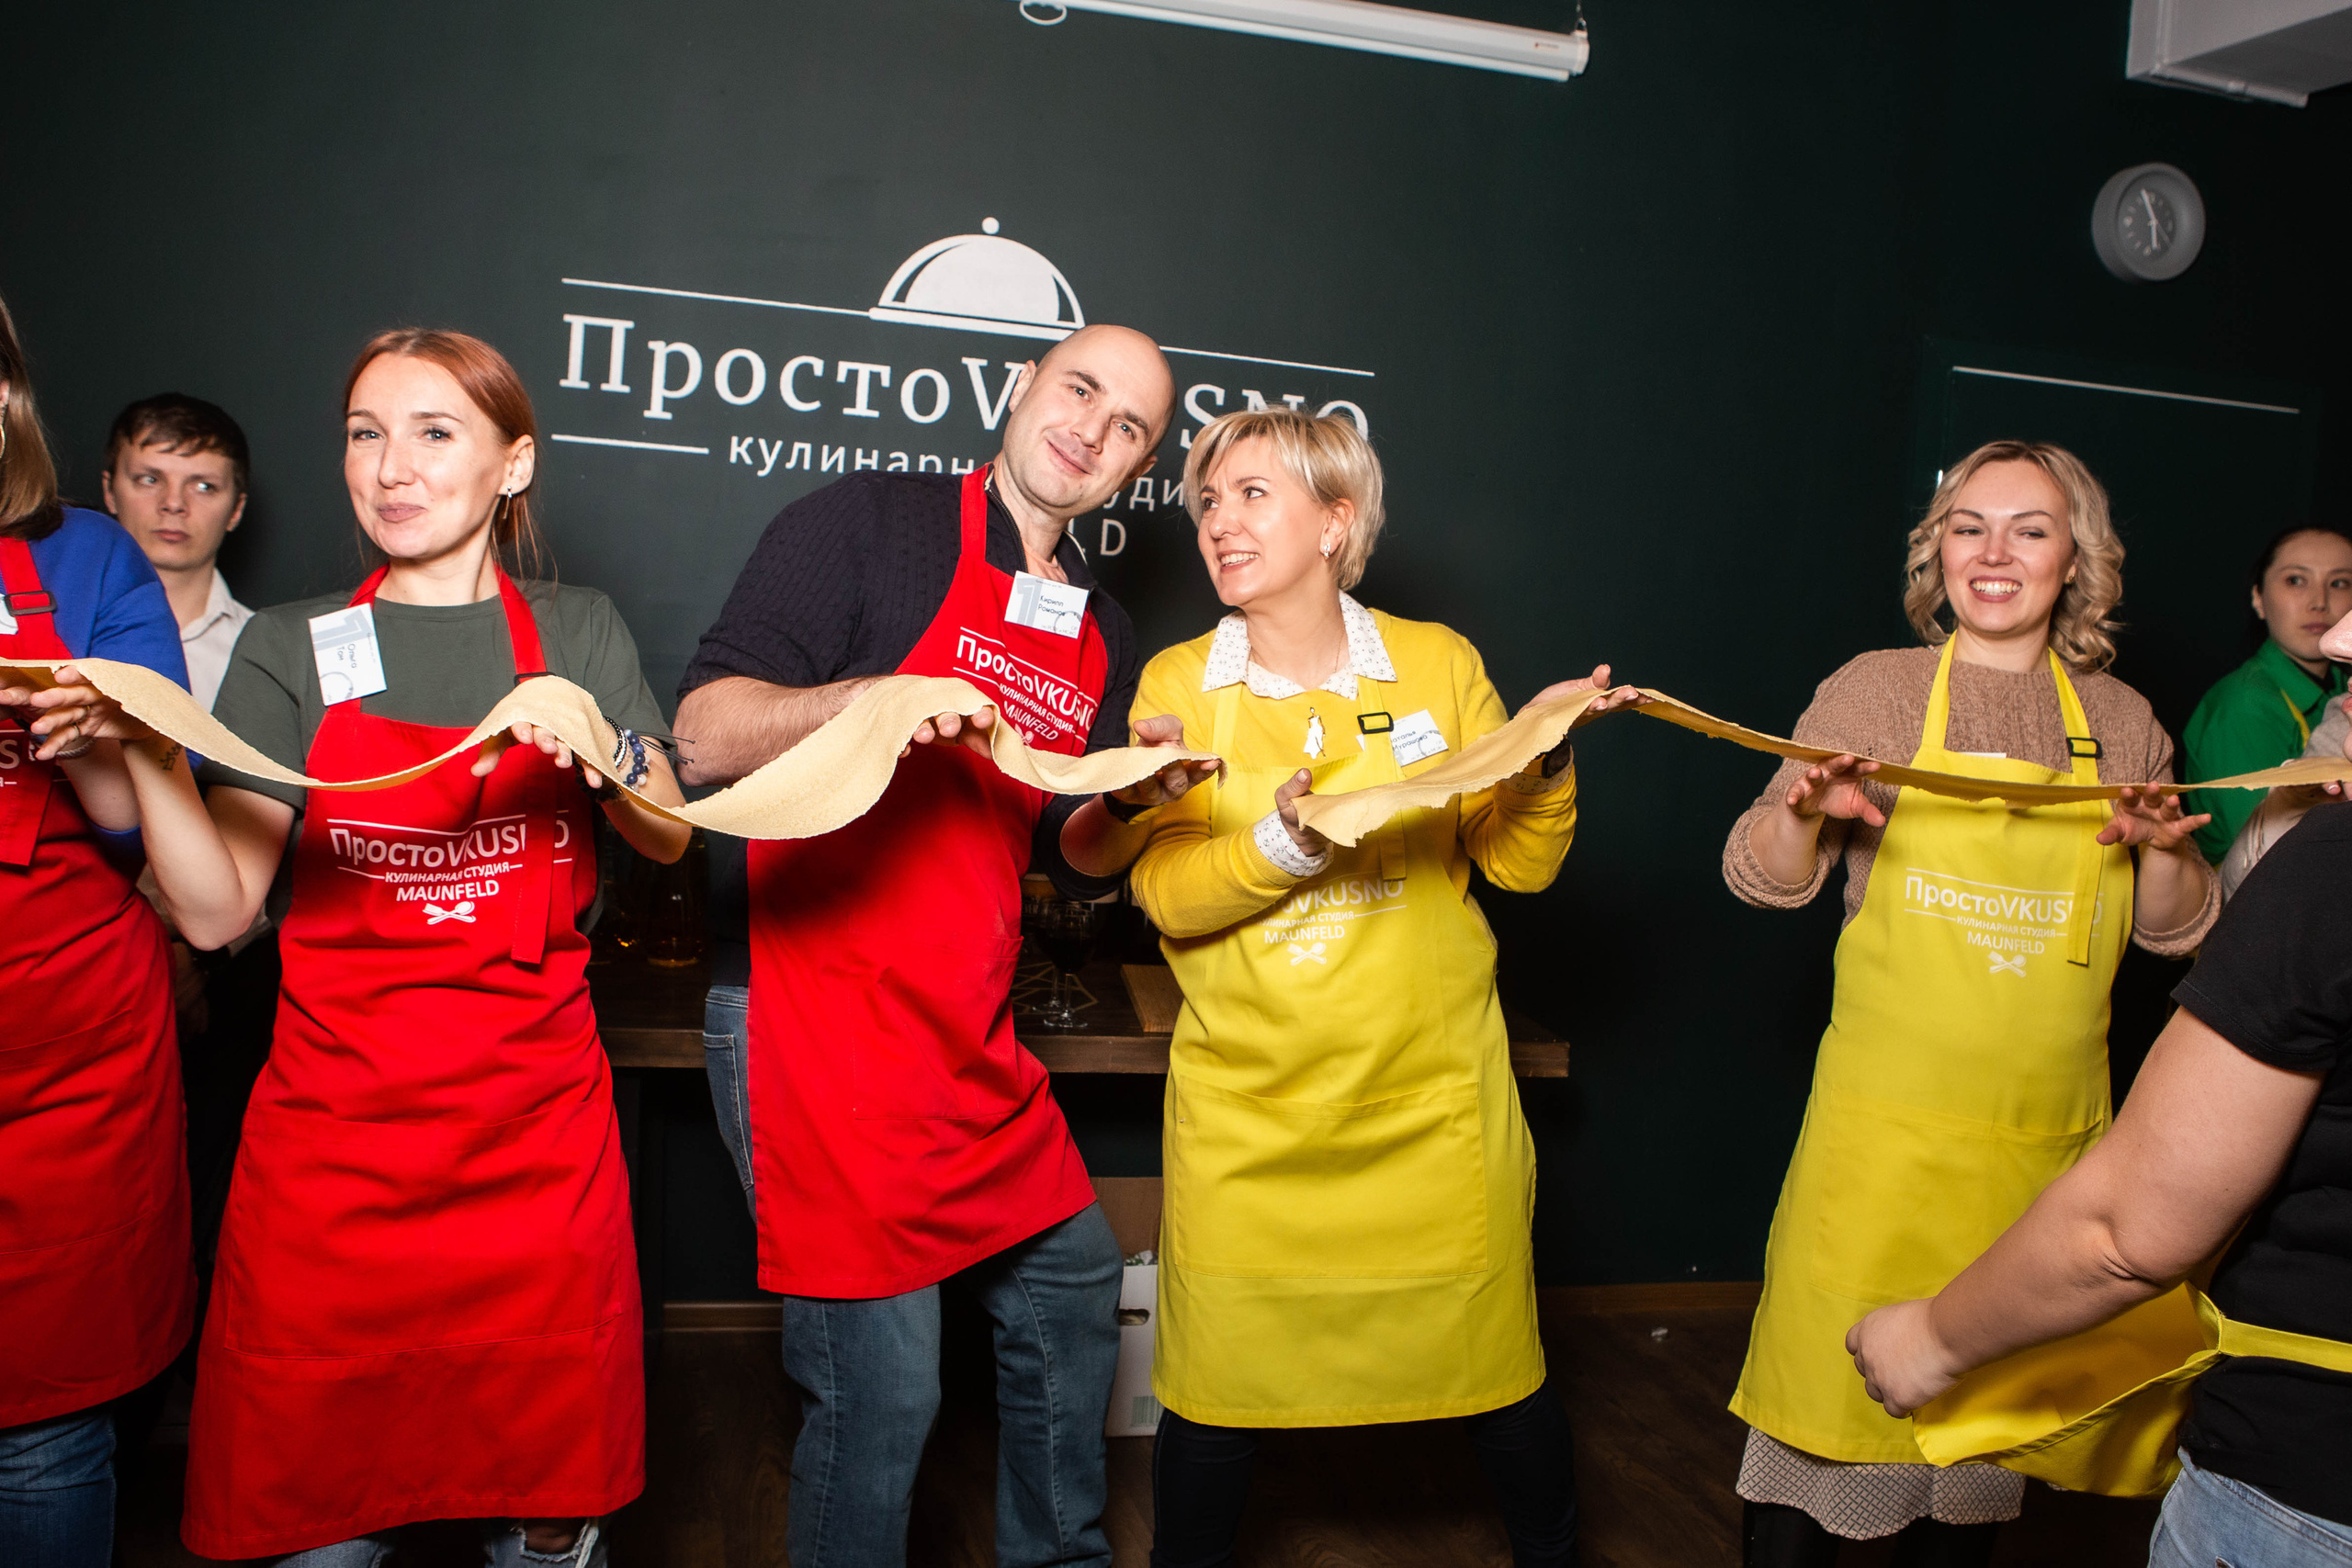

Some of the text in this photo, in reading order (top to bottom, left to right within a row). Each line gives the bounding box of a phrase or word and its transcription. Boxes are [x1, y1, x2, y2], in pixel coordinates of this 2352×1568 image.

[1046, 712, 1073, 733] СТУДИЯ
[385, 862, 509, 884] КУЛИНАРНАЯ СТУДИЯ
[396, 879, 500, 902] MAUNFELD
[1317, 910, 1354, 922] СТУДИЯ
[1956, 915, 2056, 939] КУЛИНАРНАЯ СТУДИЯ
[1264, 924, 1345, 944] MAUNFELD
[1967, 930, 2045, 954] MAUNFELD
